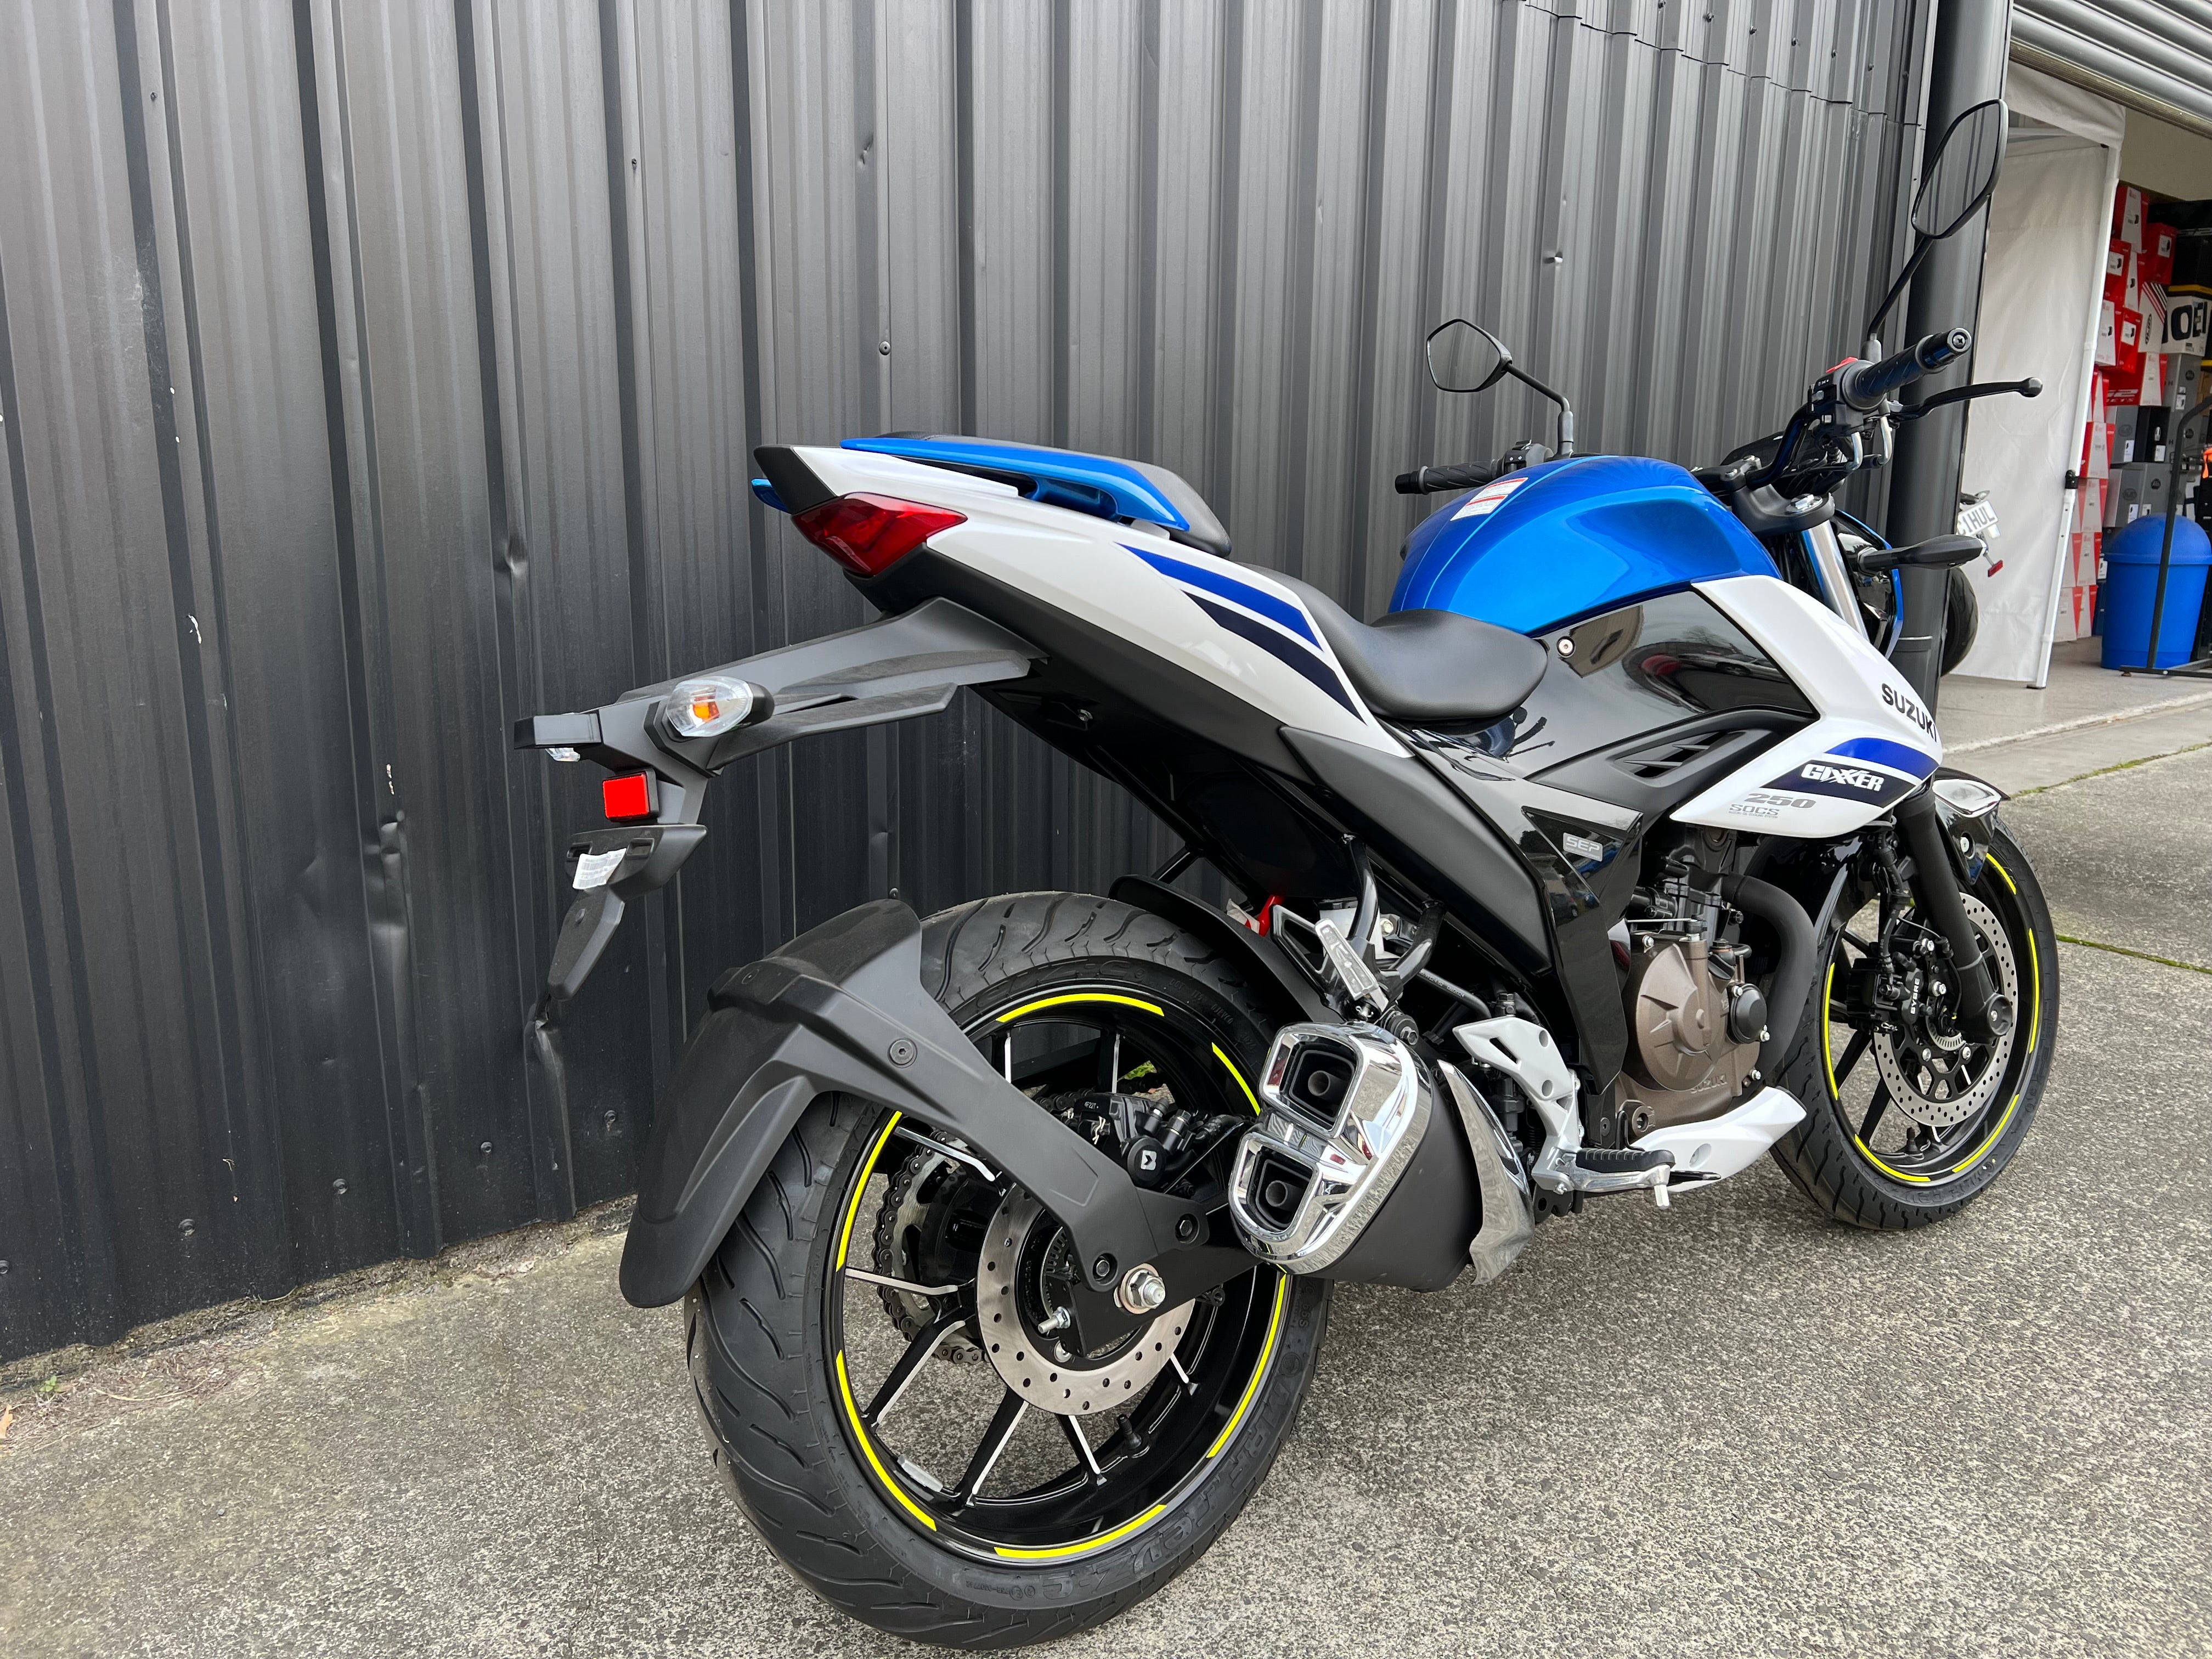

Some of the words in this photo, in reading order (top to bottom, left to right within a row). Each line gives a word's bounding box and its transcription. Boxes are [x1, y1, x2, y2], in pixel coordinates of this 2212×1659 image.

[1882, 683, 1937, 743] SUZUKI
[1801, 764, 1884, 792] GIXXER
[1729, 804, 1780, 816] SOCS
[1744, 793, 1816, 809] 250
[1566, 836, 1600, 852] SEP
[1910, 978, 1920, 1015] BYBRE
